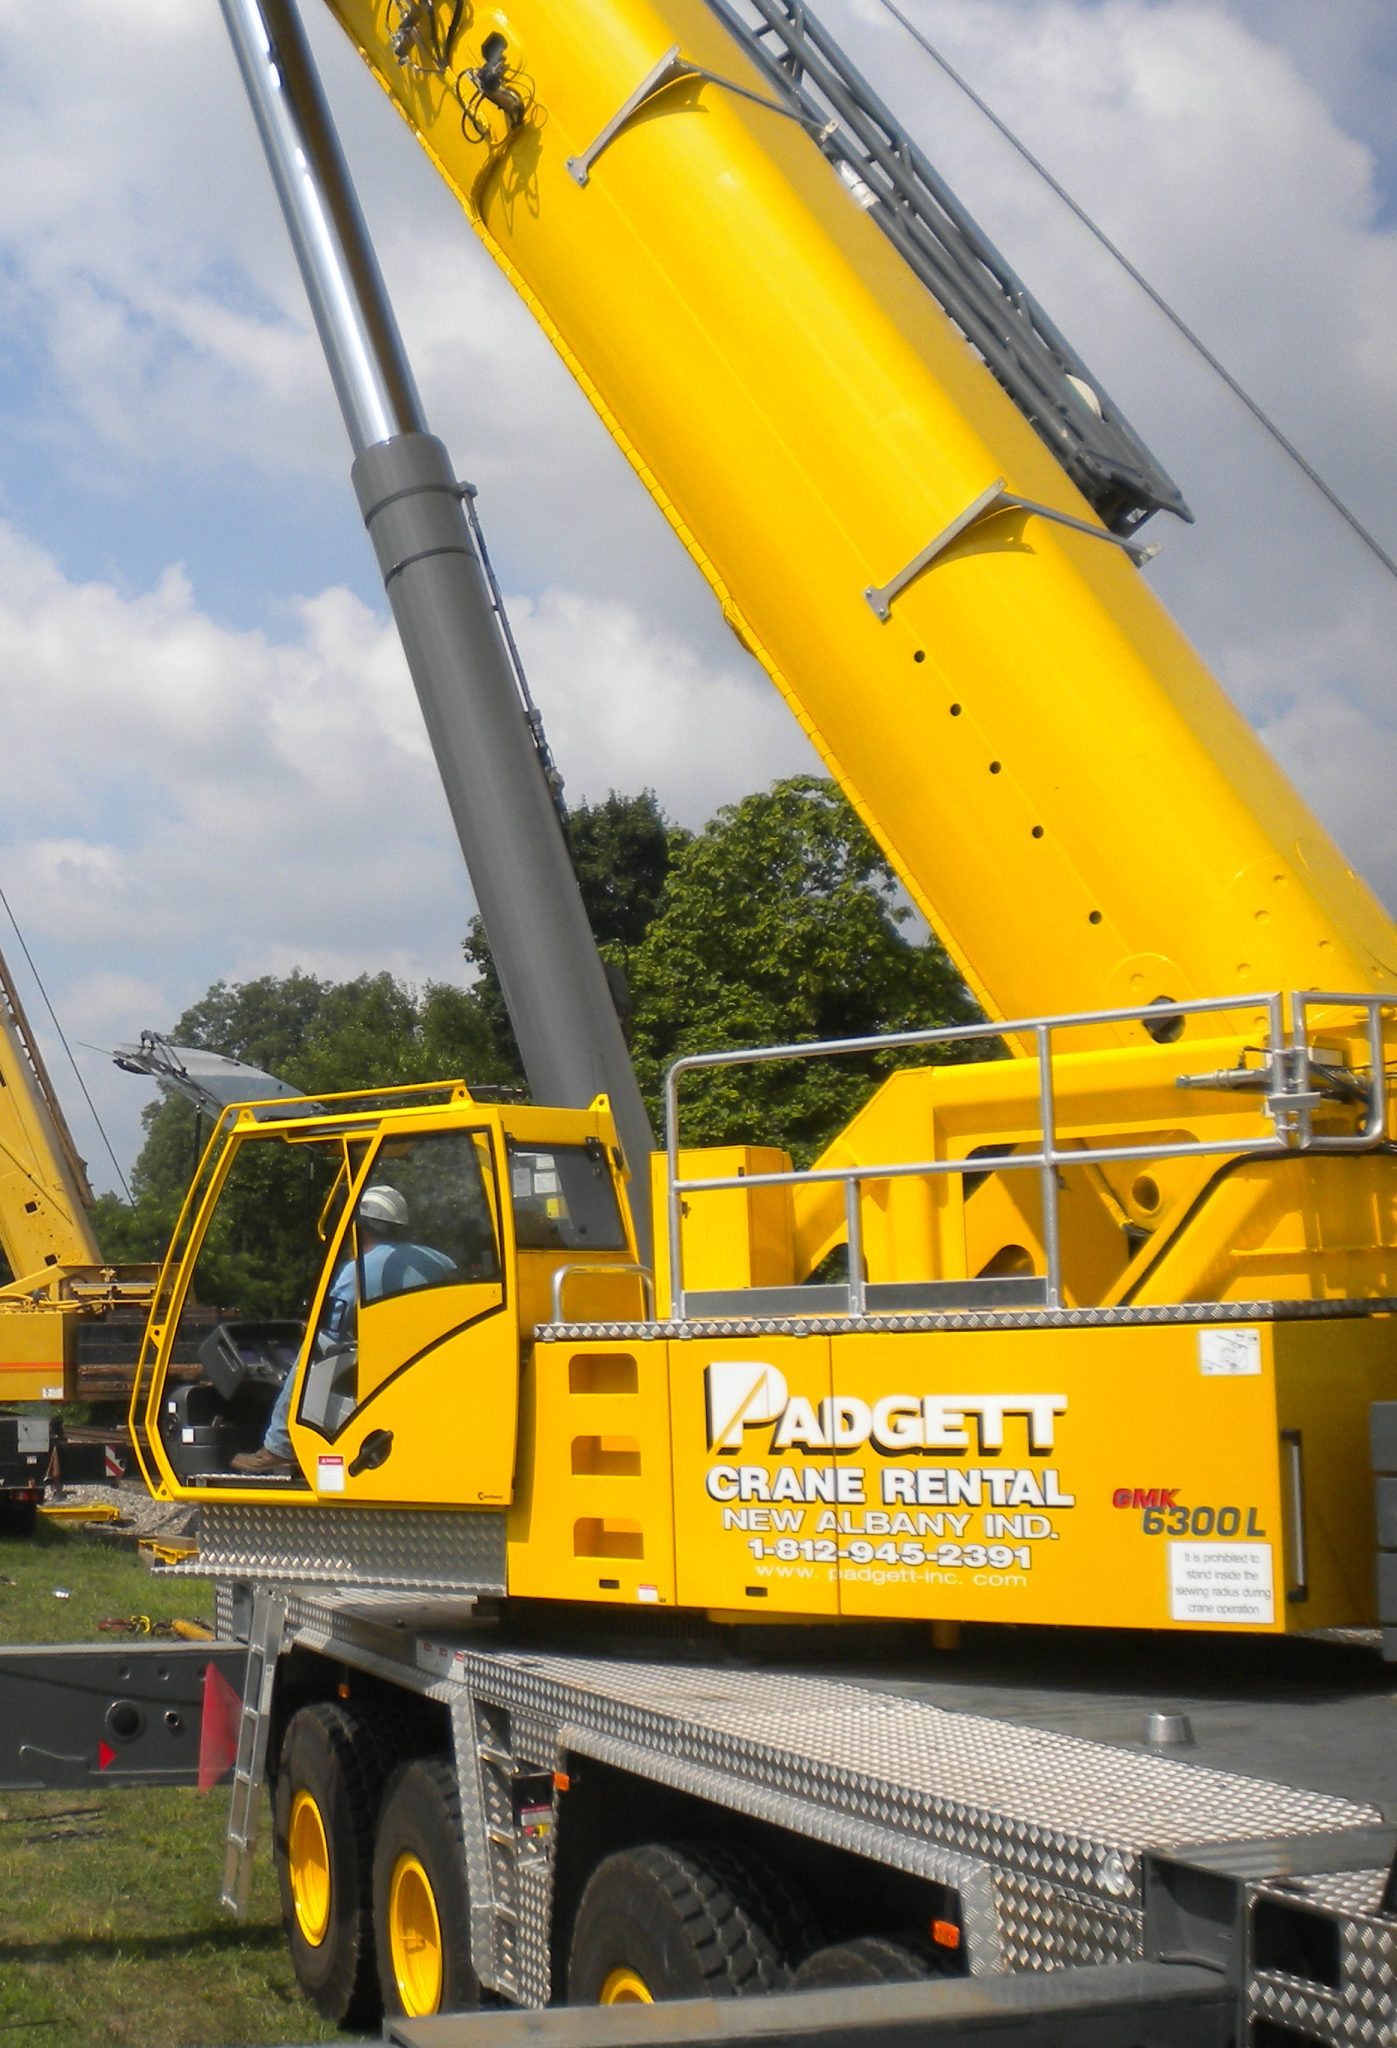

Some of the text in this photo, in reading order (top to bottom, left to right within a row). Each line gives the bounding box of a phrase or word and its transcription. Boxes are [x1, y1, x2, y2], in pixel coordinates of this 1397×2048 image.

[705, 1361, 1068, 1456] PADGETT
[706, 1465, 1075, 1507] CRANE RENTAL
[1112, 1488, 1181, 1509] GMK
[723, 1508, 1060, 1539] NEW ALBANY IND.
[747, 1538, 1032, 1569] 1-812-945-2391
[1184, 1552, 1260, 1563] It is prohibited to
[1186, 1569, 1259, 1580] stand inside the
[1175, 1586, 1271, 1600] slewing radius during
[1188, 1604, 1259, 1614] crane operation
